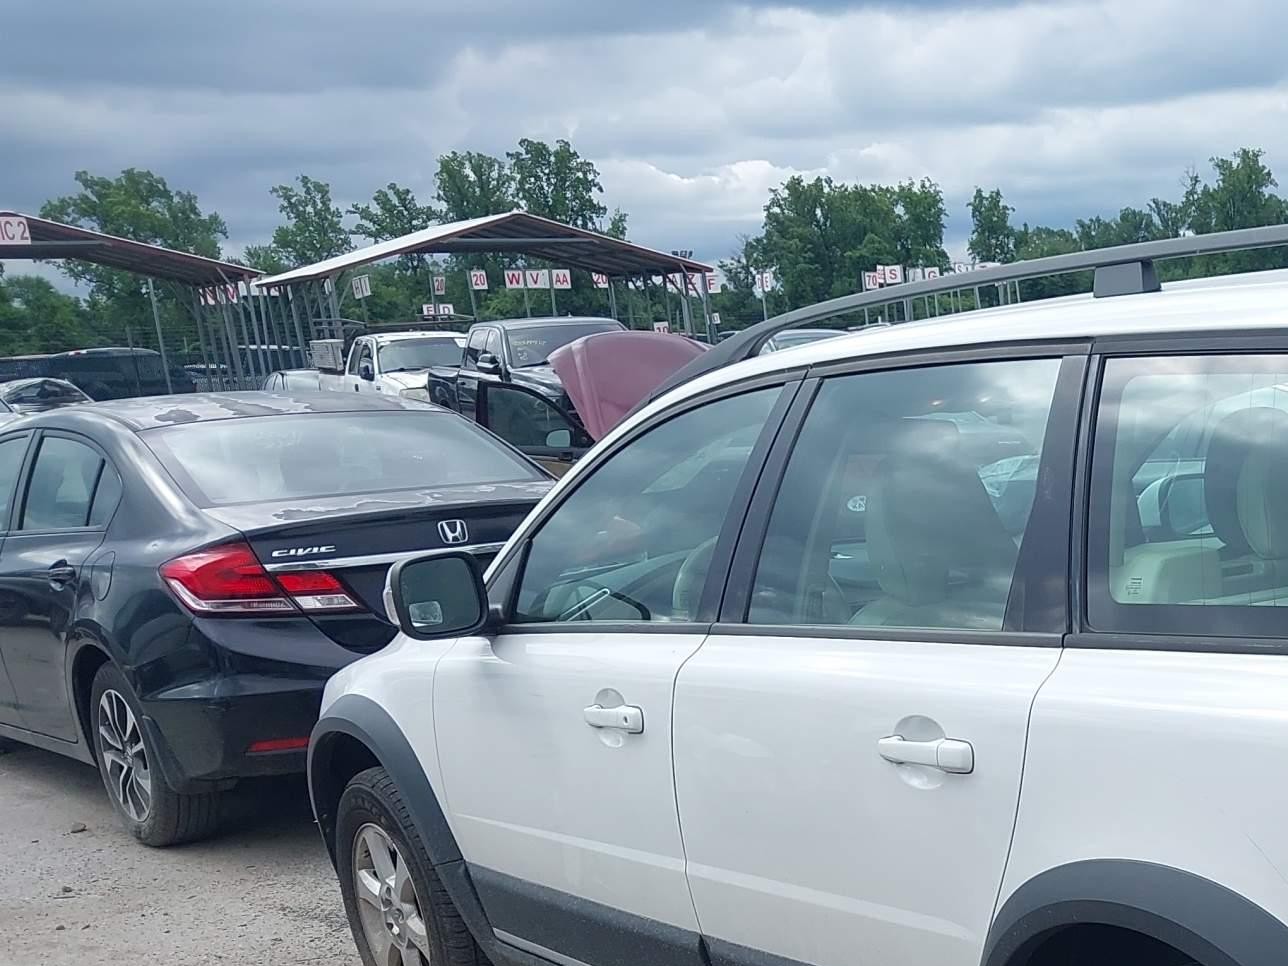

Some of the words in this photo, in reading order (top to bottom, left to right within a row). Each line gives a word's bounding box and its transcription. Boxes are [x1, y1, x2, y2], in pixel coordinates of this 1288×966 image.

[472, 273, 485, 286] 20
[507, 272, 521, 285] W
[555, 273, 569, 285] AA
[866, 275, 877, 286] 70
[889, 269, 897, 280] S
[435, 278, 444, 291] 20
[271, 545, 337, 558] CIVIC
